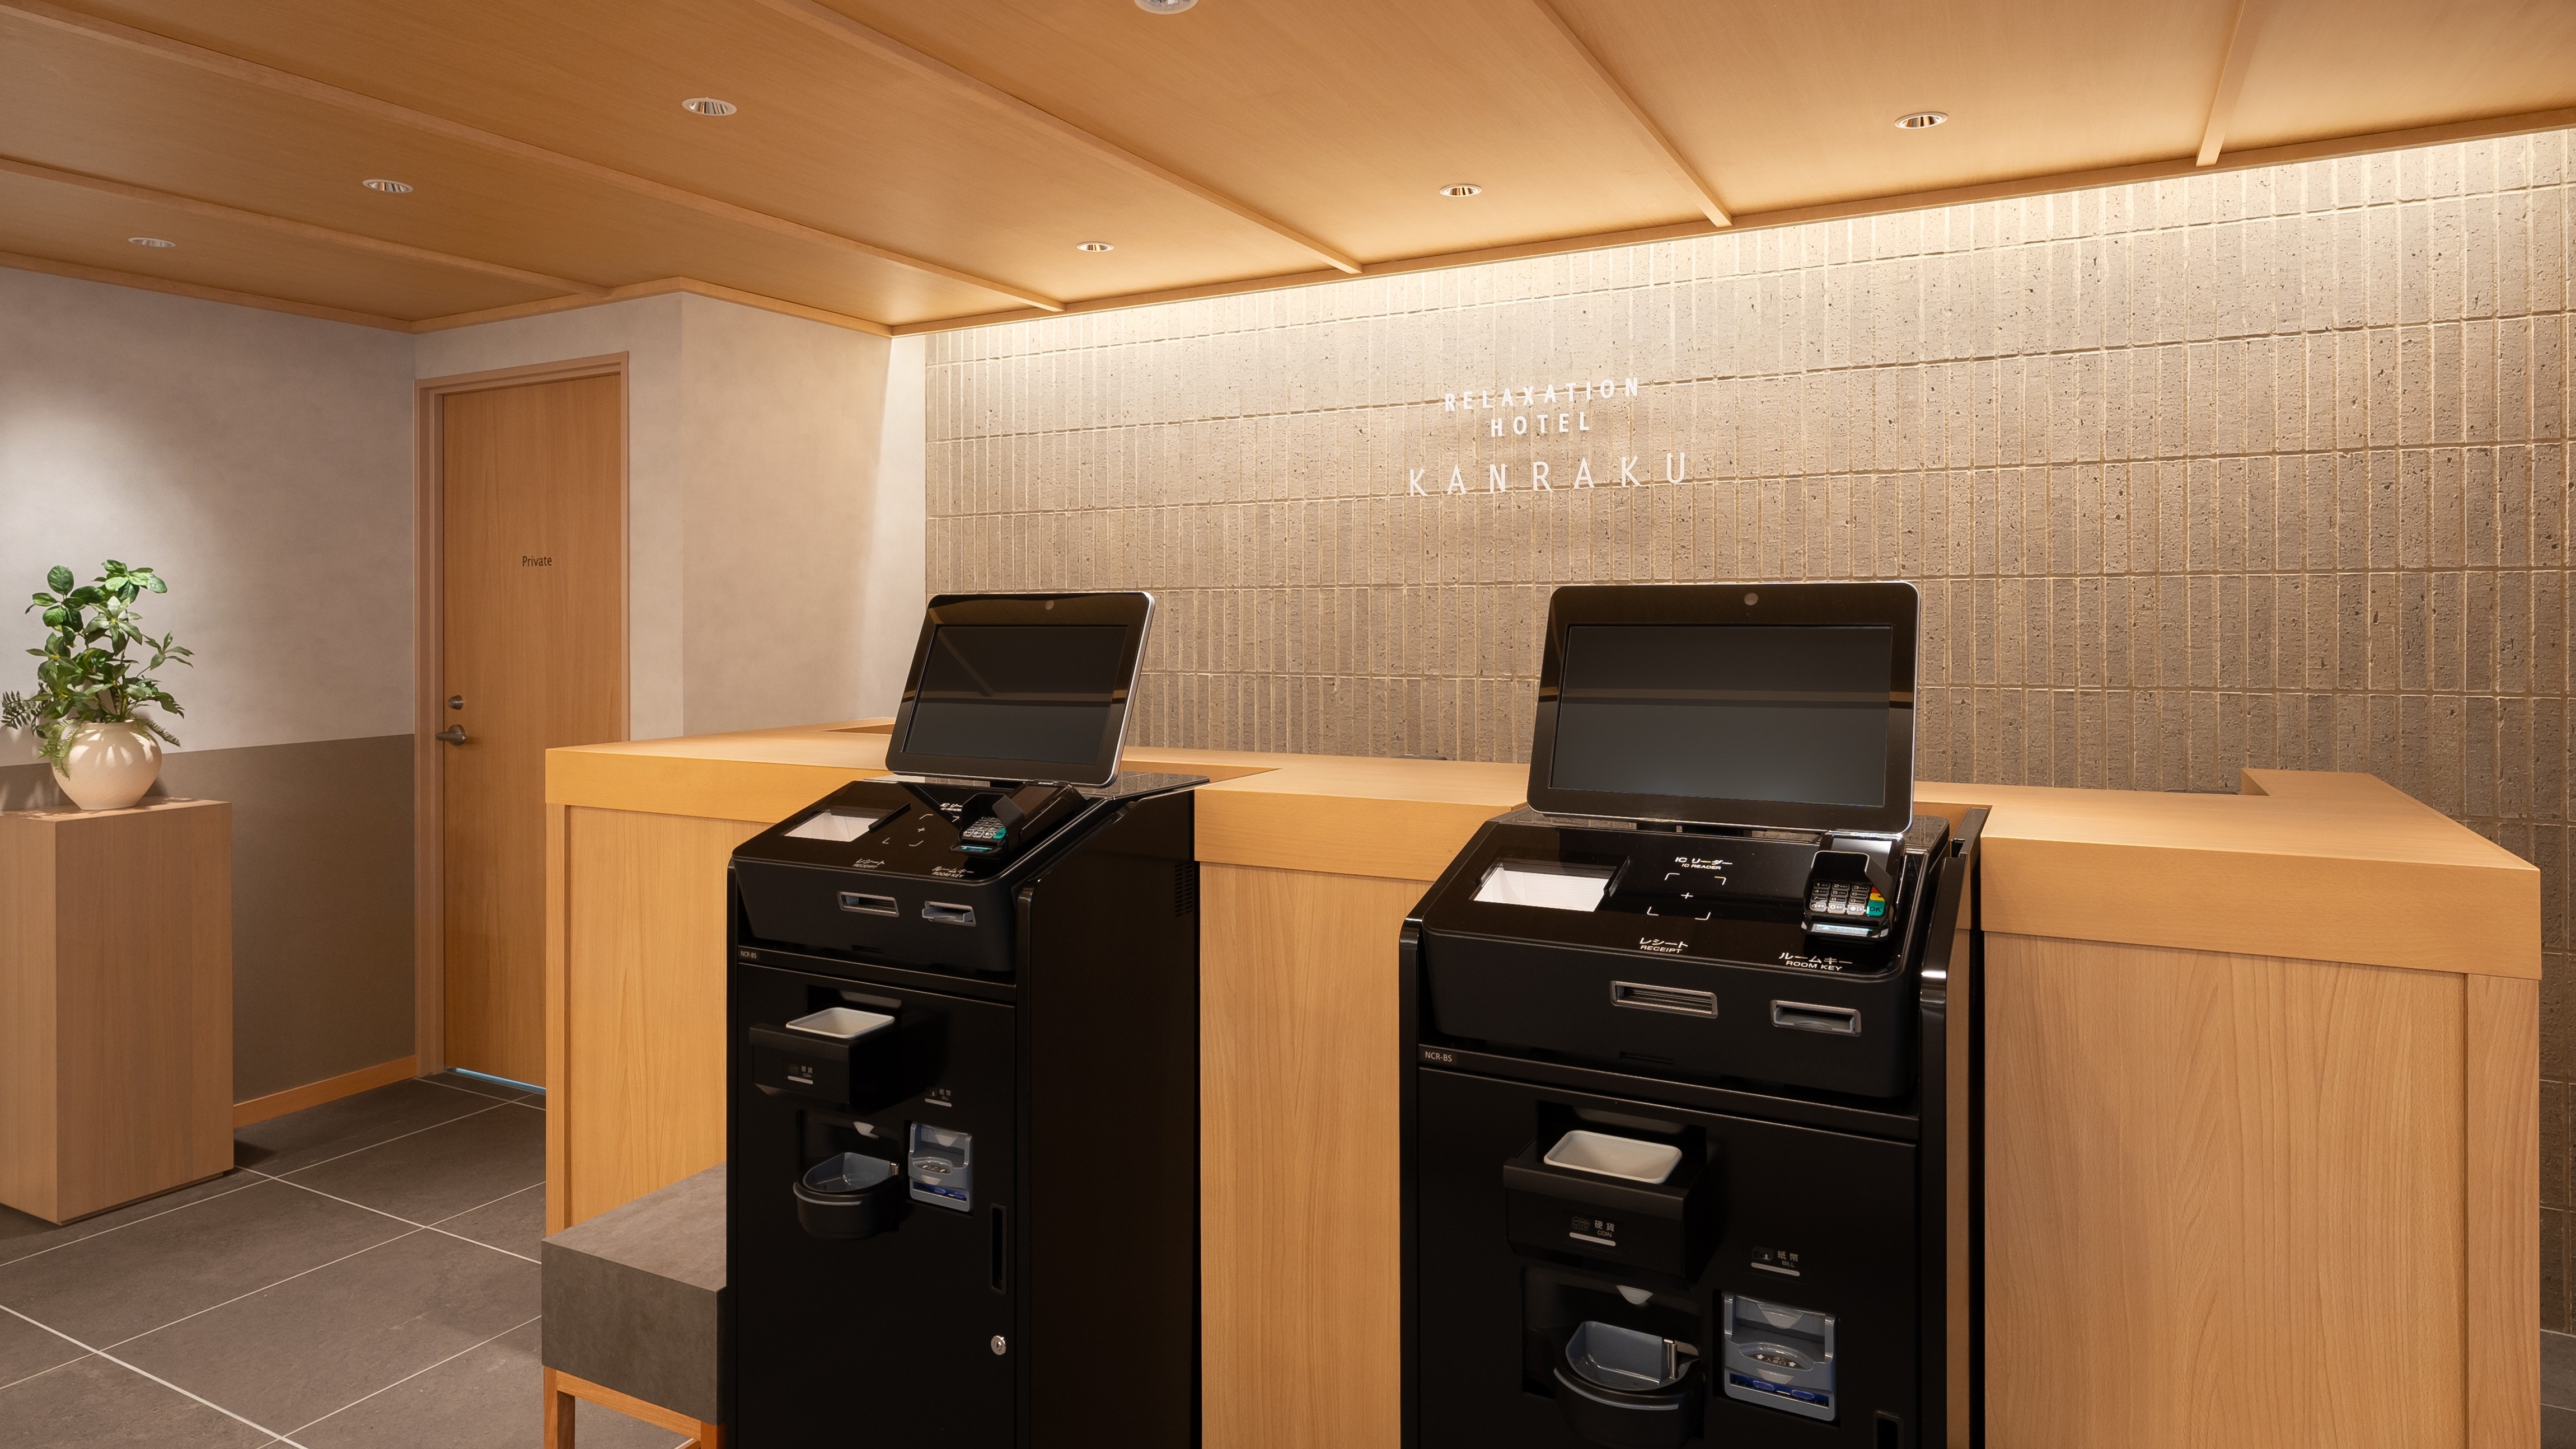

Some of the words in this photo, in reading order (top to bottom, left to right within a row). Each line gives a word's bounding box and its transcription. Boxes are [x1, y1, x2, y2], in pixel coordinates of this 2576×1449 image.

[1444, 377, 1638, 412] RELAXATION
[1490, 411, 1590, 438] HOTEL
[1409, 452, 1686, 497] KANRAKU
[522, 556, 552, 567] Private
[1639, 937, 1688, 948] レシート
[1640, 945, 1683, 953] RECEIPT
[1778, 952, 1853, 965] ルームキー
[1425, 1051, 1452, 1062] NCR-BS
[1594, 1220, 1615, 1232] 硬貨
